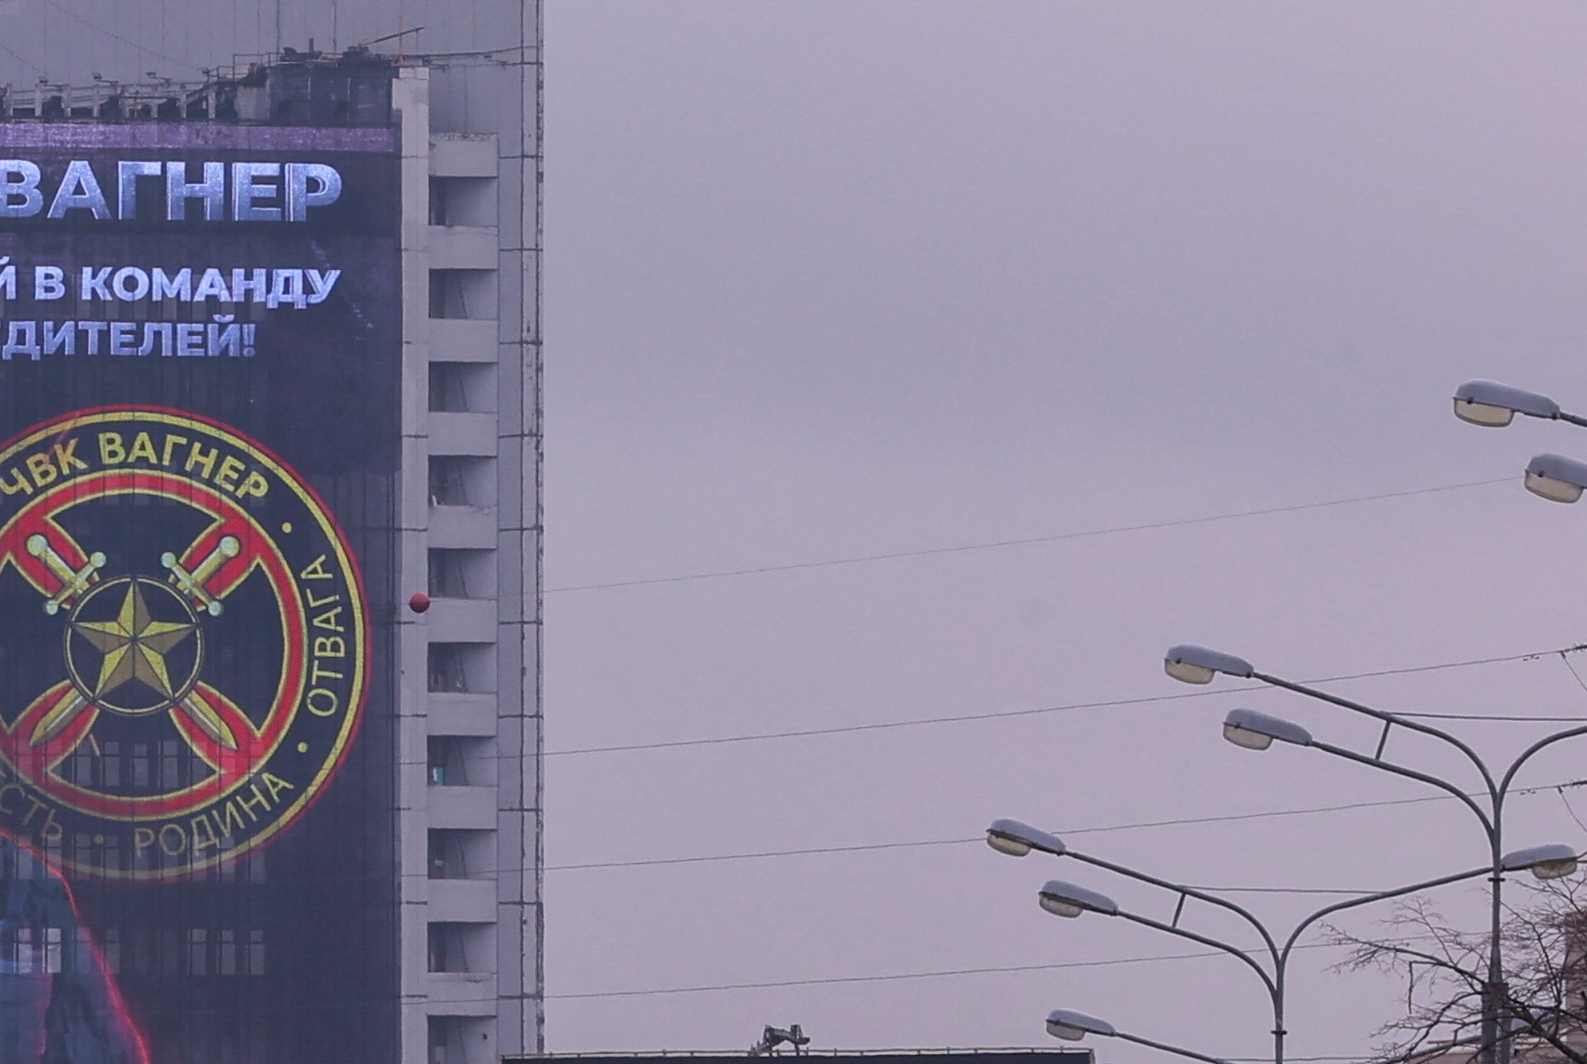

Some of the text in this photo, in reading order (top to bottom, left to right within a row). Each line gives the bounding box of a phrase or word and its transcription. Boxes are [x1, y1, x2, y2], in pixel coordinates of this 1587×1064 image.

[34, 265, 66, 300] В
[81, 264, 341, 309] КОМАНДУ
[98, 431, 270, 502] ВАГНЕР
[301, 554, 346, 718] ОТВАГА
[133, 771, 295, 859] РОДИНА
